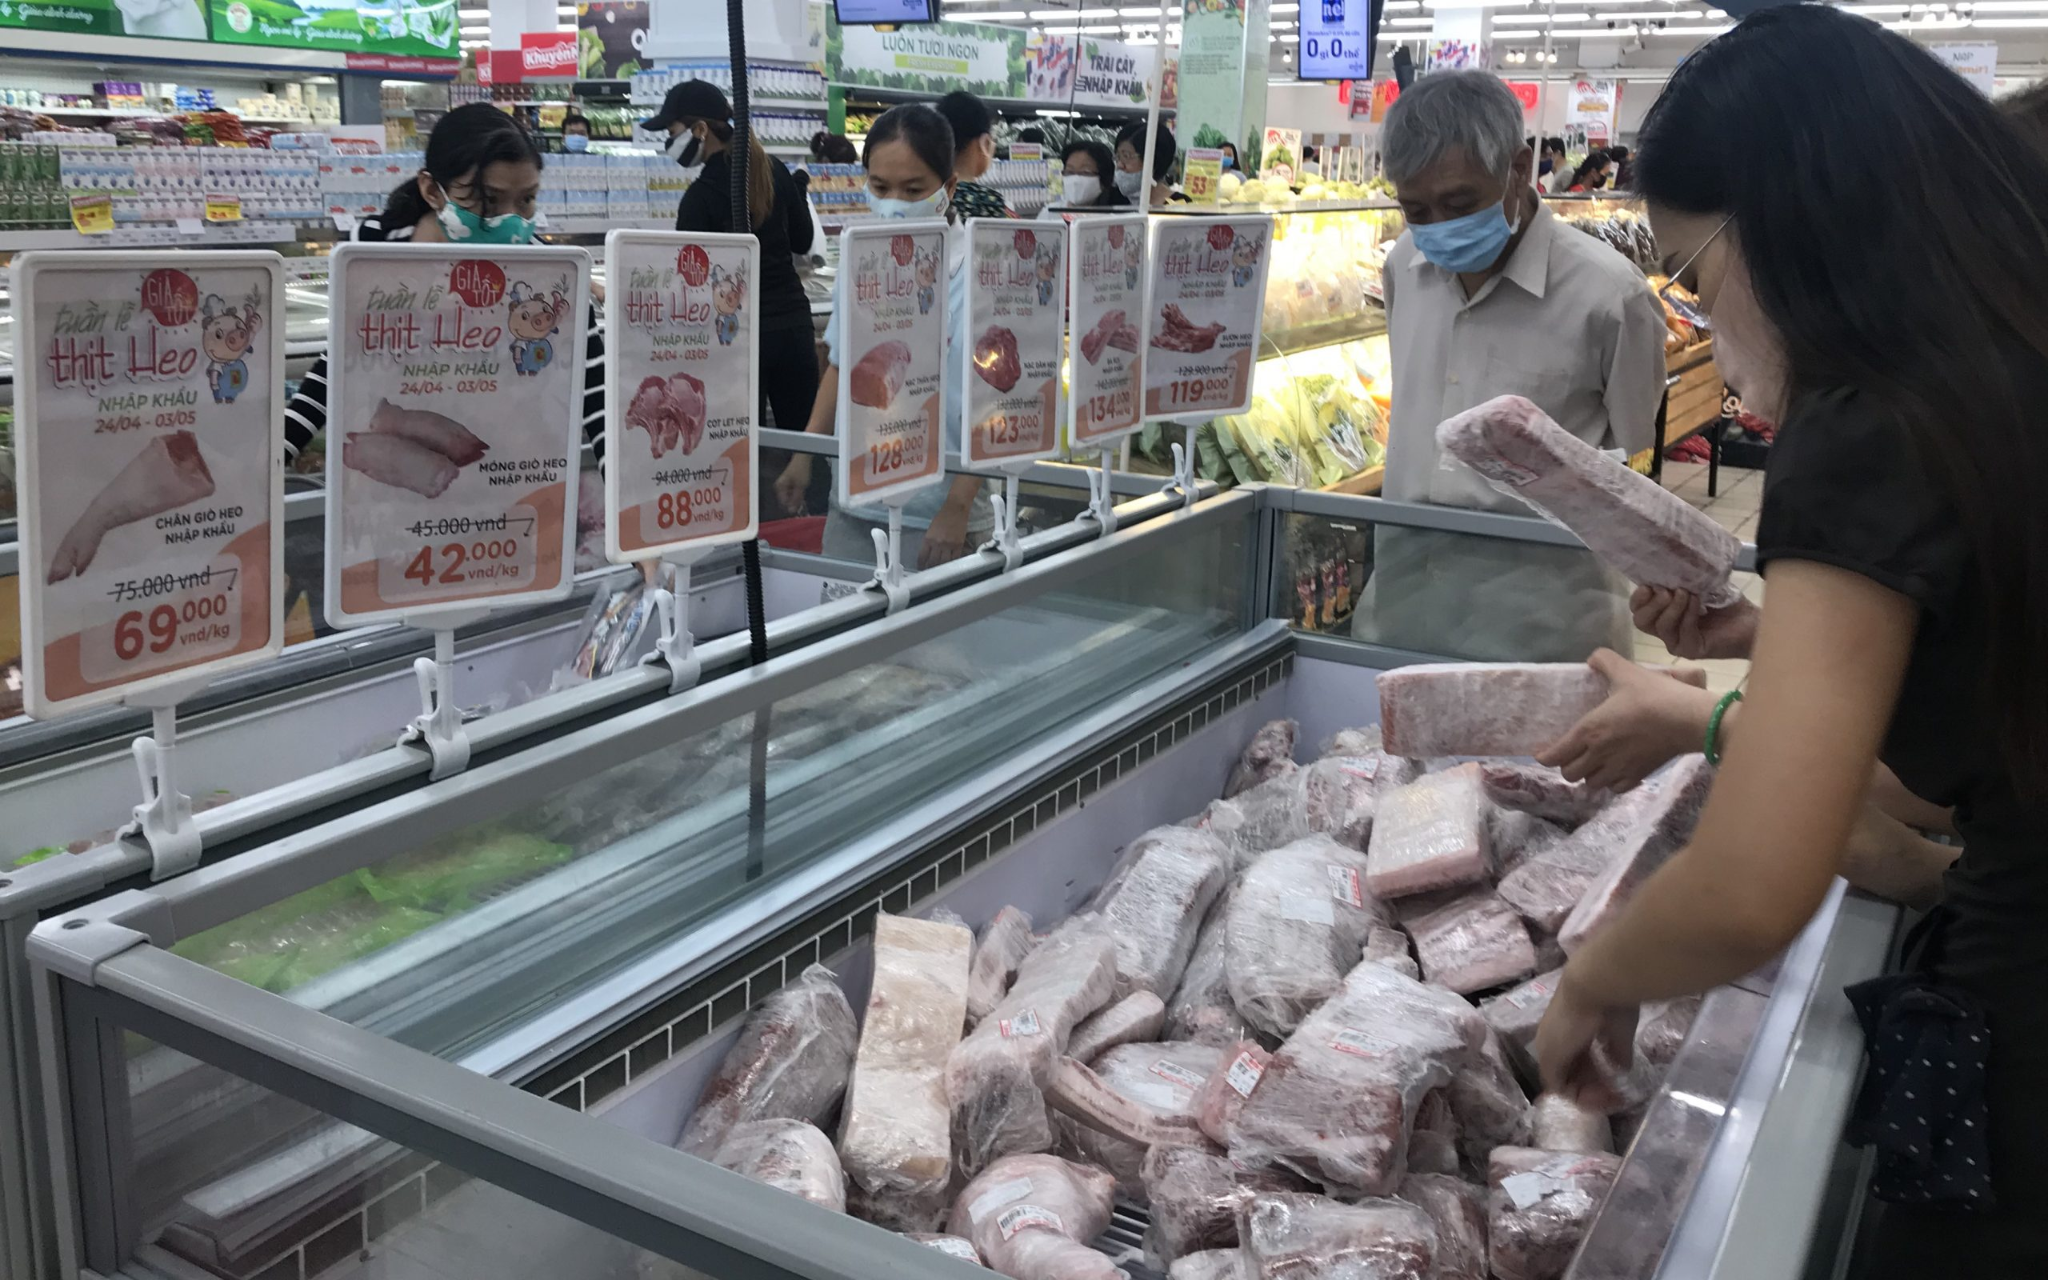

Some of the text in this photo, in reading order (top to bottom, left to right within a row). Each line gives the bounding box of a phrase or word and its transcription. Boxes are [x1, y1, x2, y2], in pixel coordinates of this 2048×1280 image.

[882, 34, 979, 60] LUÔN TƯƠI NGON
[1307, 38, 1318, 57] 0
[1331, 38, 1342, 57] 0
[1090, 52, 1114, 71] TRÁI
[1084, 73, 1142, 98] NHẬP KHẨU
[1192, 176, 1208, 195] 53
[626, 290, 664, 334] thịt
[359, 313, 421, 359] thịt
[652, 332, 710, 350] NHẬP KHẨU
[49, 334, 116, 391] thịt
[650, 351, 677, 362] 24/04
[684, 349, 709, 361] 03/05
[403, 356, 500, 381] NHẬP KHẨU
[400, 381, 443, 395] 24/04
[457, 379, 498, 394] 03/05
[99, 386, 198, 413] NHẬP KHẨU
[94, 416, 142, 434] 24/04
[155, 411, 196, 428] 03/05
[478, 458, 568, 473] MÓNG GIÒ HEO
[489, 468, 558, 487] NHẬP KHẨU
[655, 467, 691, 487] 94.000
[155, 506, 244, 530] CHÂN GIÒ HEO
[693, 509, 725, 523] vnd/kg
[165, 520, 236, 545] NHẬP KHẨU
[410, 517, 471, 537] 45.000
[468, 562, 519, 579] vnd/kg
[113, 574, 175, 602] 75.000
[180, 624, 230, 646] vnd/kg
